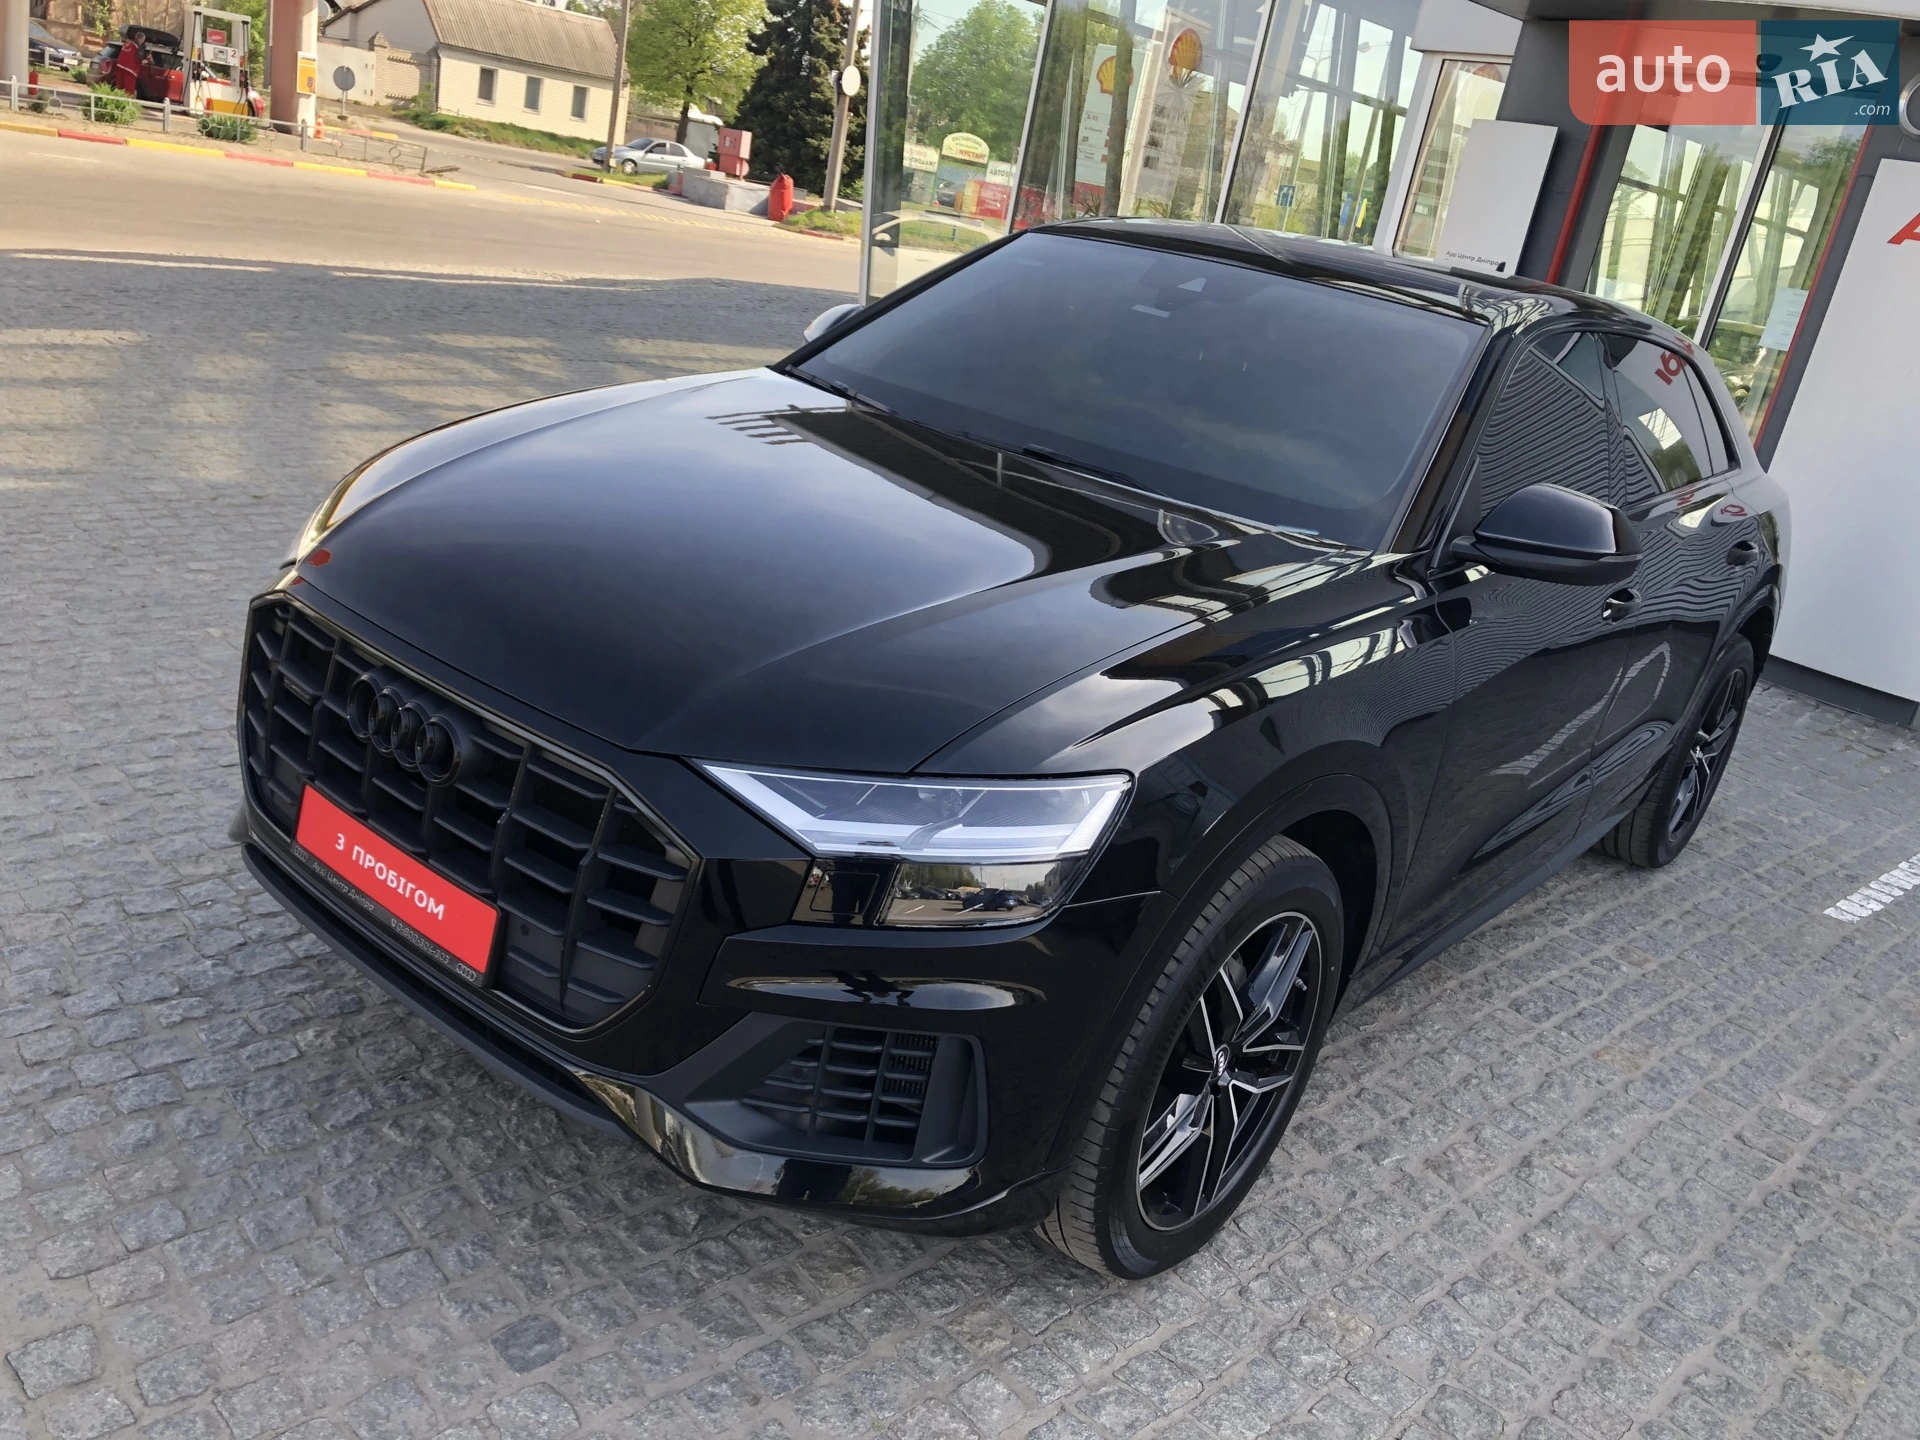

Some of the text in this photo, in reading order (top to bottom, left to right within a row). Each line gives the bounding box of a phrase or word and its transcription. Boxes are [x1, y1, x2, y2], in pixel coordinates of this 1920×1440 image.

[231, 49, 237, 58] 2
[1457, 252, 1475, 262] Центр
[1475, 256, 1500, 266] Дніпро
[327, 870, 349, 893] Центр
[347, 888, 375, 911] Дніпро
[351, 845, 445, 921] ПРОБІГОМ
